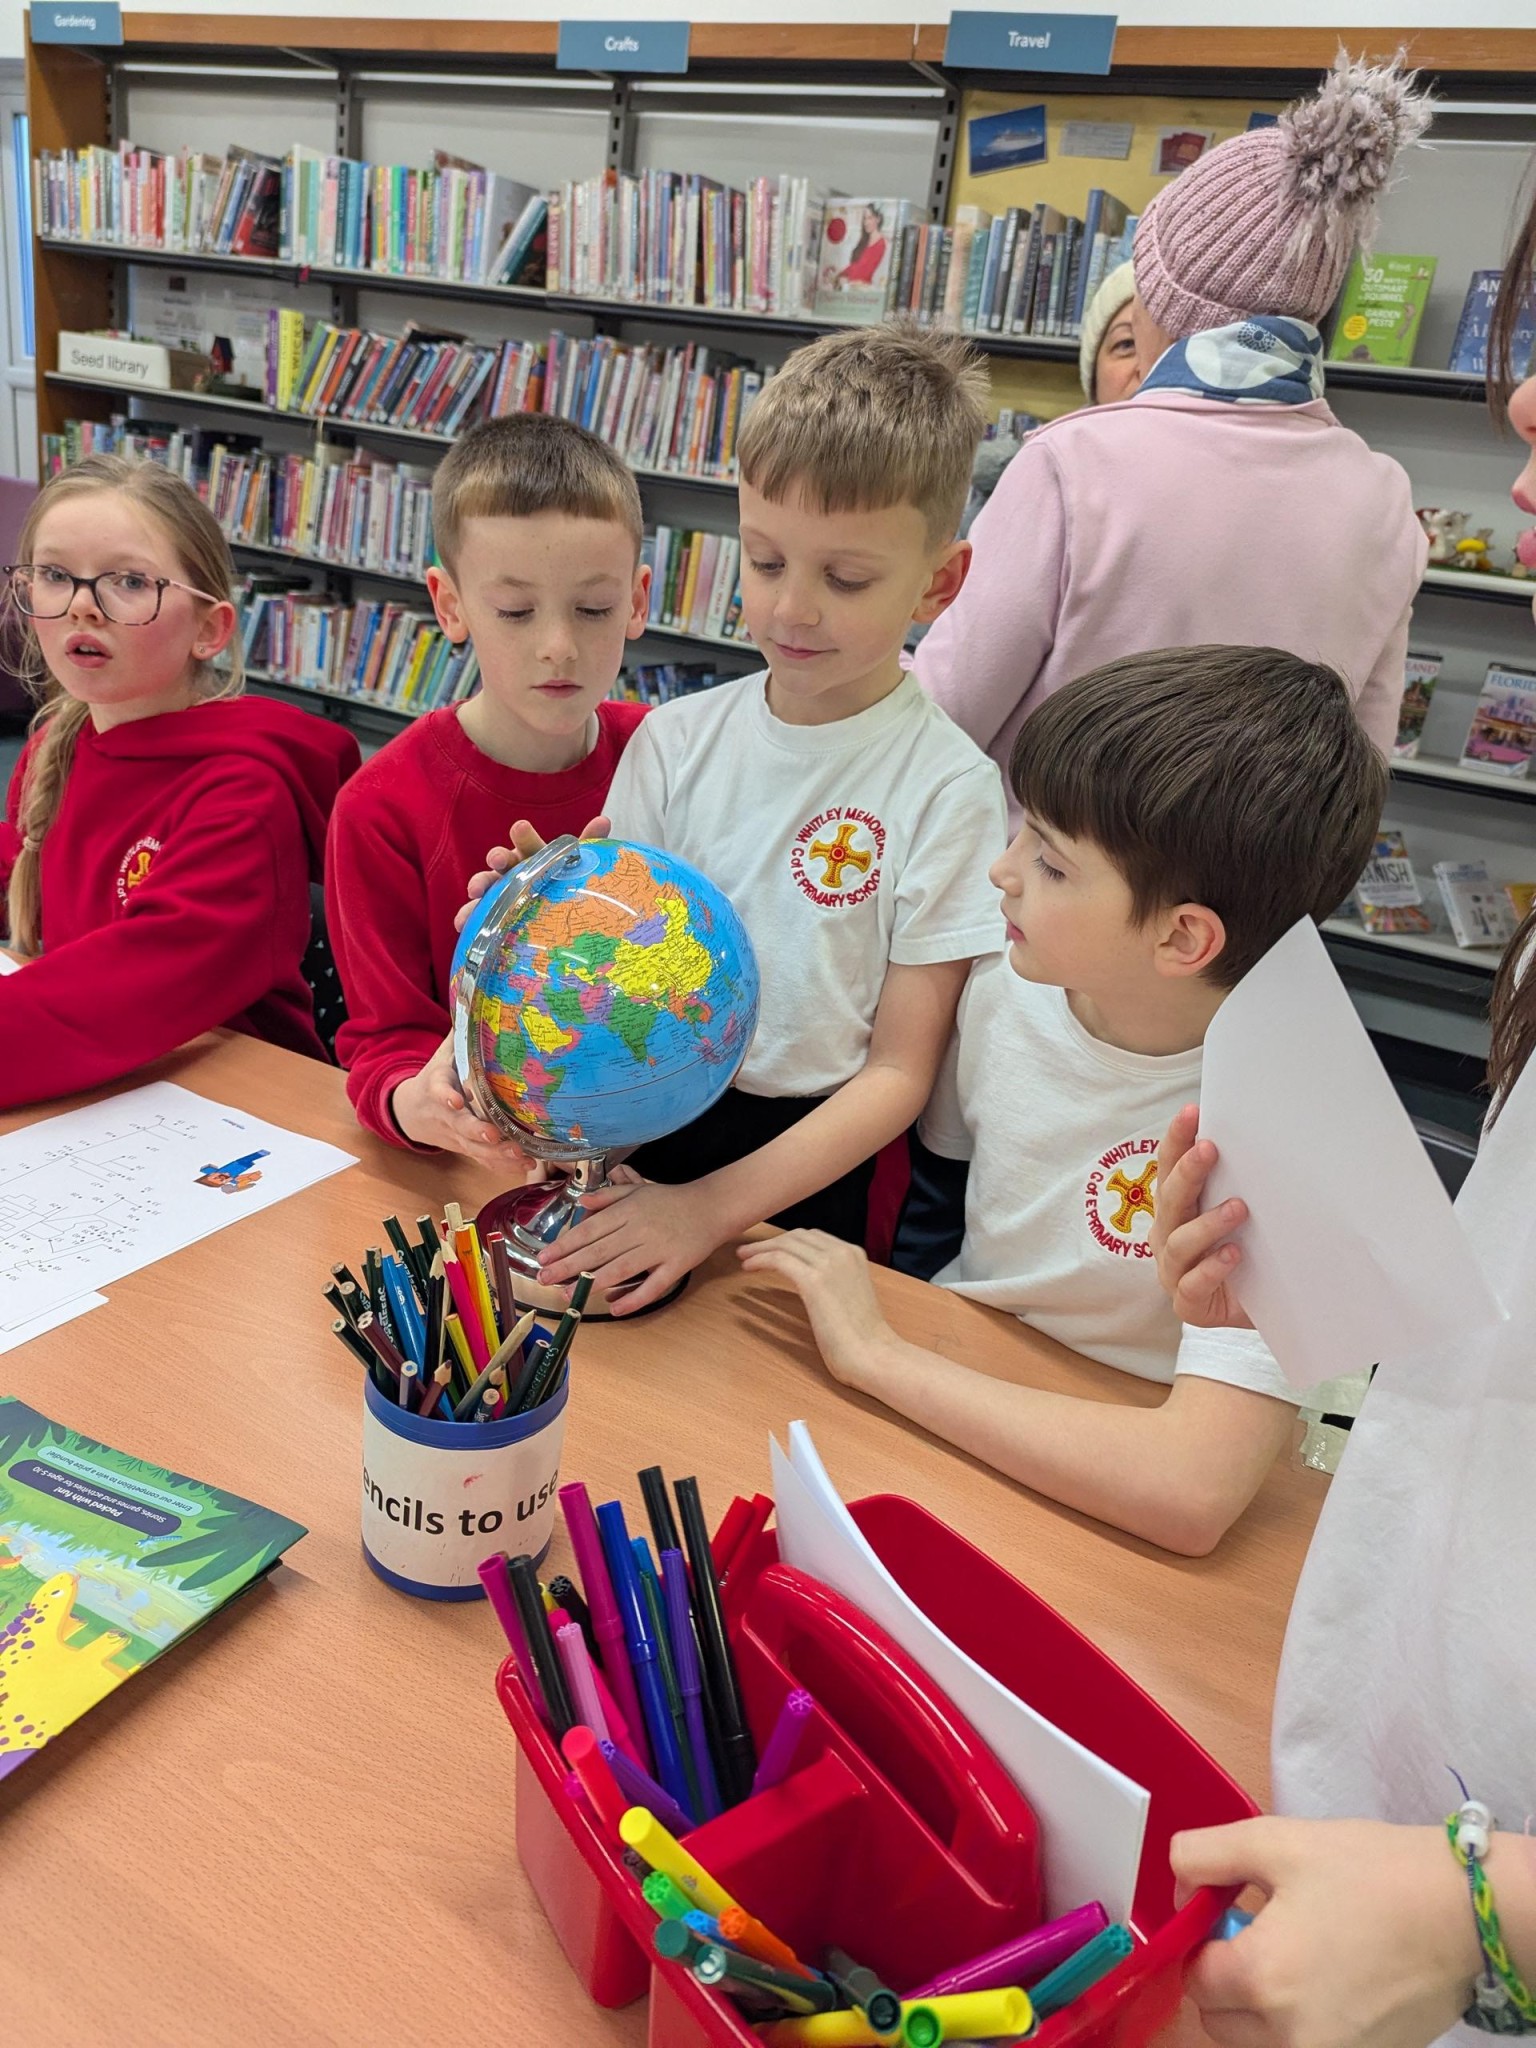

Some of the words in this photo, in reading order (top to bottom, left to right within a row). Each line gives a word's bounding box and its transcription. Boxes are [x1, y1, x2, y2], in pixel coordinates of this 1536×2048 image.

[54, 15, 97, 31] Gardening
[604, 36, 640, 52] Crafts
[1008, 31, 1052, 49] Travel
[70, 349, 105, 370] Seed
[107, 354, 150, 380] library
[1490, 673, 1536, 692] FLORID
[795, 807, 842, 844] WHITLEY
[843, 807, 887, 861] MEMORIAL
[791, 847, 805, 858] C
[792, 869, 806, 881] E
[797, 878, 846, 908] PRIMARY
[1097, 1139, 1160, 1170] WHITLEY
[1090, 1171, 1105, 1183] C
[1085, 1199, 1098, 1209] E
[1085, 1209, 1132, 1258] PRIMARY
[46, 1450, 74, 1465] bundle!
[32, 1466, 49, 1476] 5-10
[72, 1462, 93, 1472] prize
[46, 1472, 65, 1482] ages
[95, 1471, 110, 1479] win
[62, 1479, 74, 1488] for
[116, 1479, 160, 1499] competition
[53, 1486, 73, 1498] fun!
[74, 1483, 104, 1500] activities
[72, 1493, 91, 1507] with
[102, 1494, 118, 1504] and
[158, 1496, 173, 1504] our
[362, 1466, 445, 1536] encils
[458, 1509, 503, 1537] to
[516, 1468, 559, 1522] use
[89, 1501, 123, 1517] Packed
[115, 1501, 142, 1513] games
[172, 1501, 193, 1512] Enter
